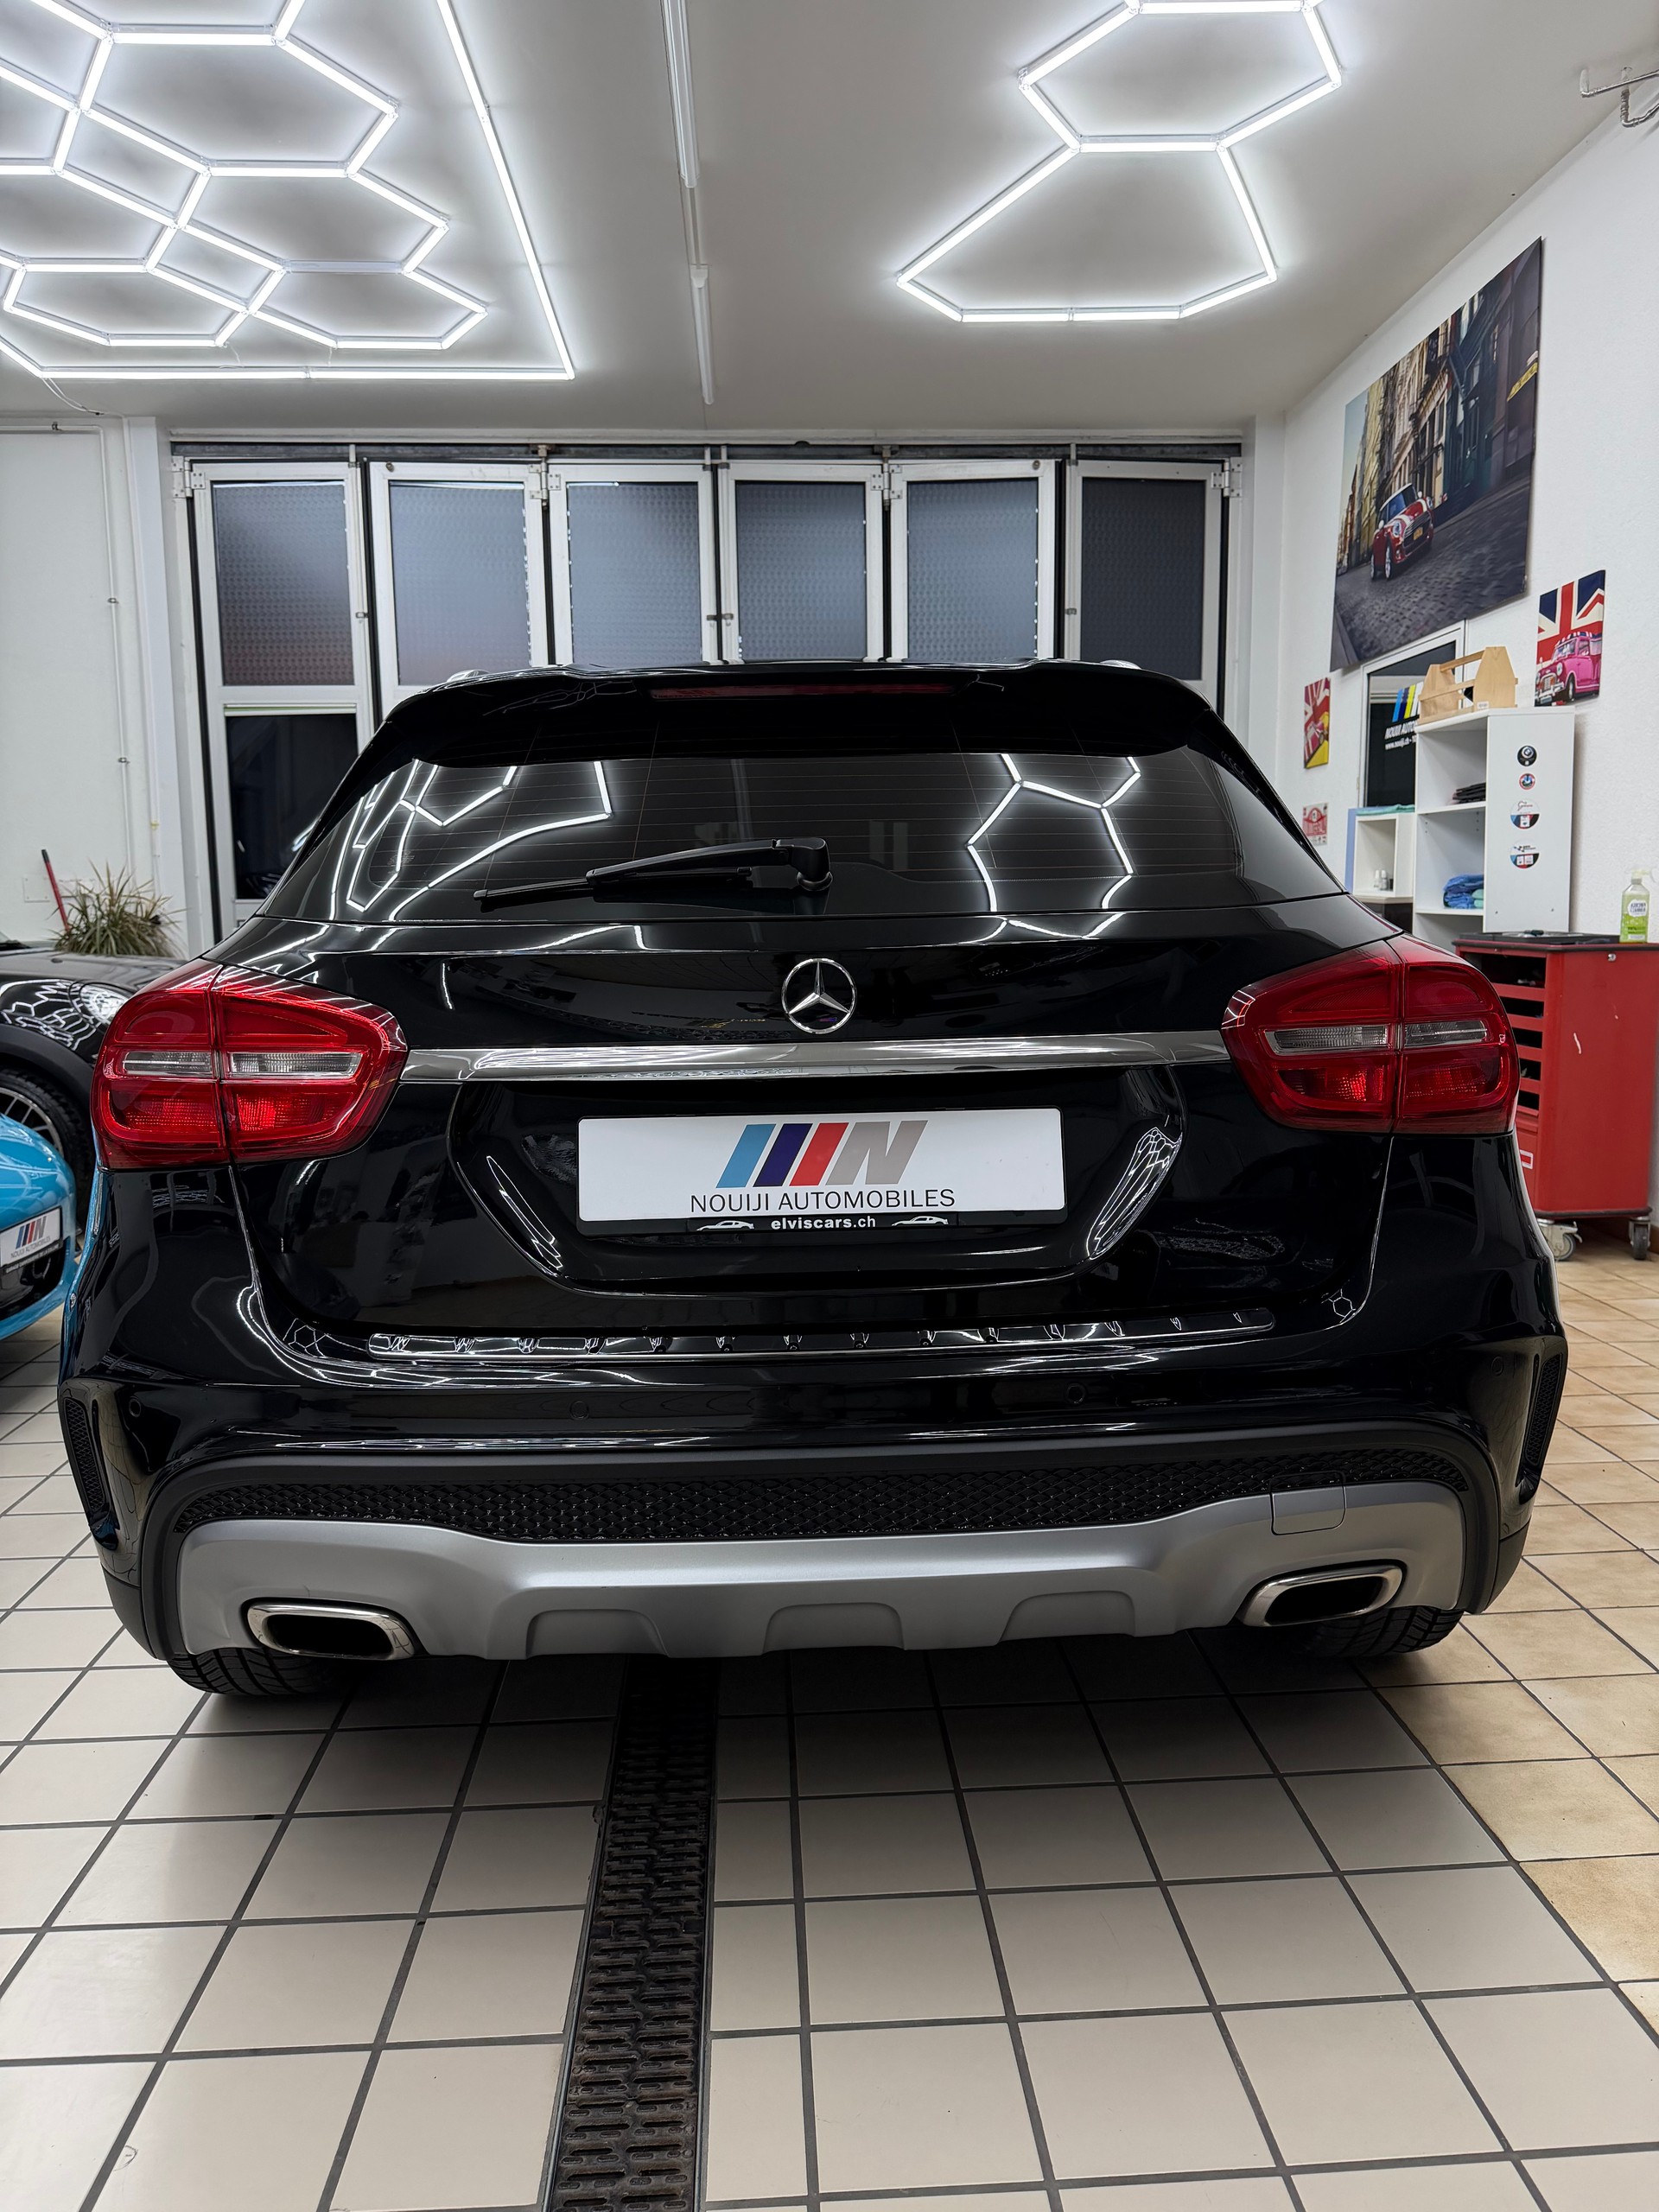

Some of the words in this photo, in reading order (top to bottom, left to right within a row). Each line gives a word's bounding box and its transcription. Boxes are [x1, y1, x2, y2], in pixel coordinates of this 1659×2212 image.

[690, 1192, 769, 1212] NOUIJI
[778, 1188, 956, 1211] AUTOMOBILES
[771, 1215, 876, 1230] elviscars.ch
